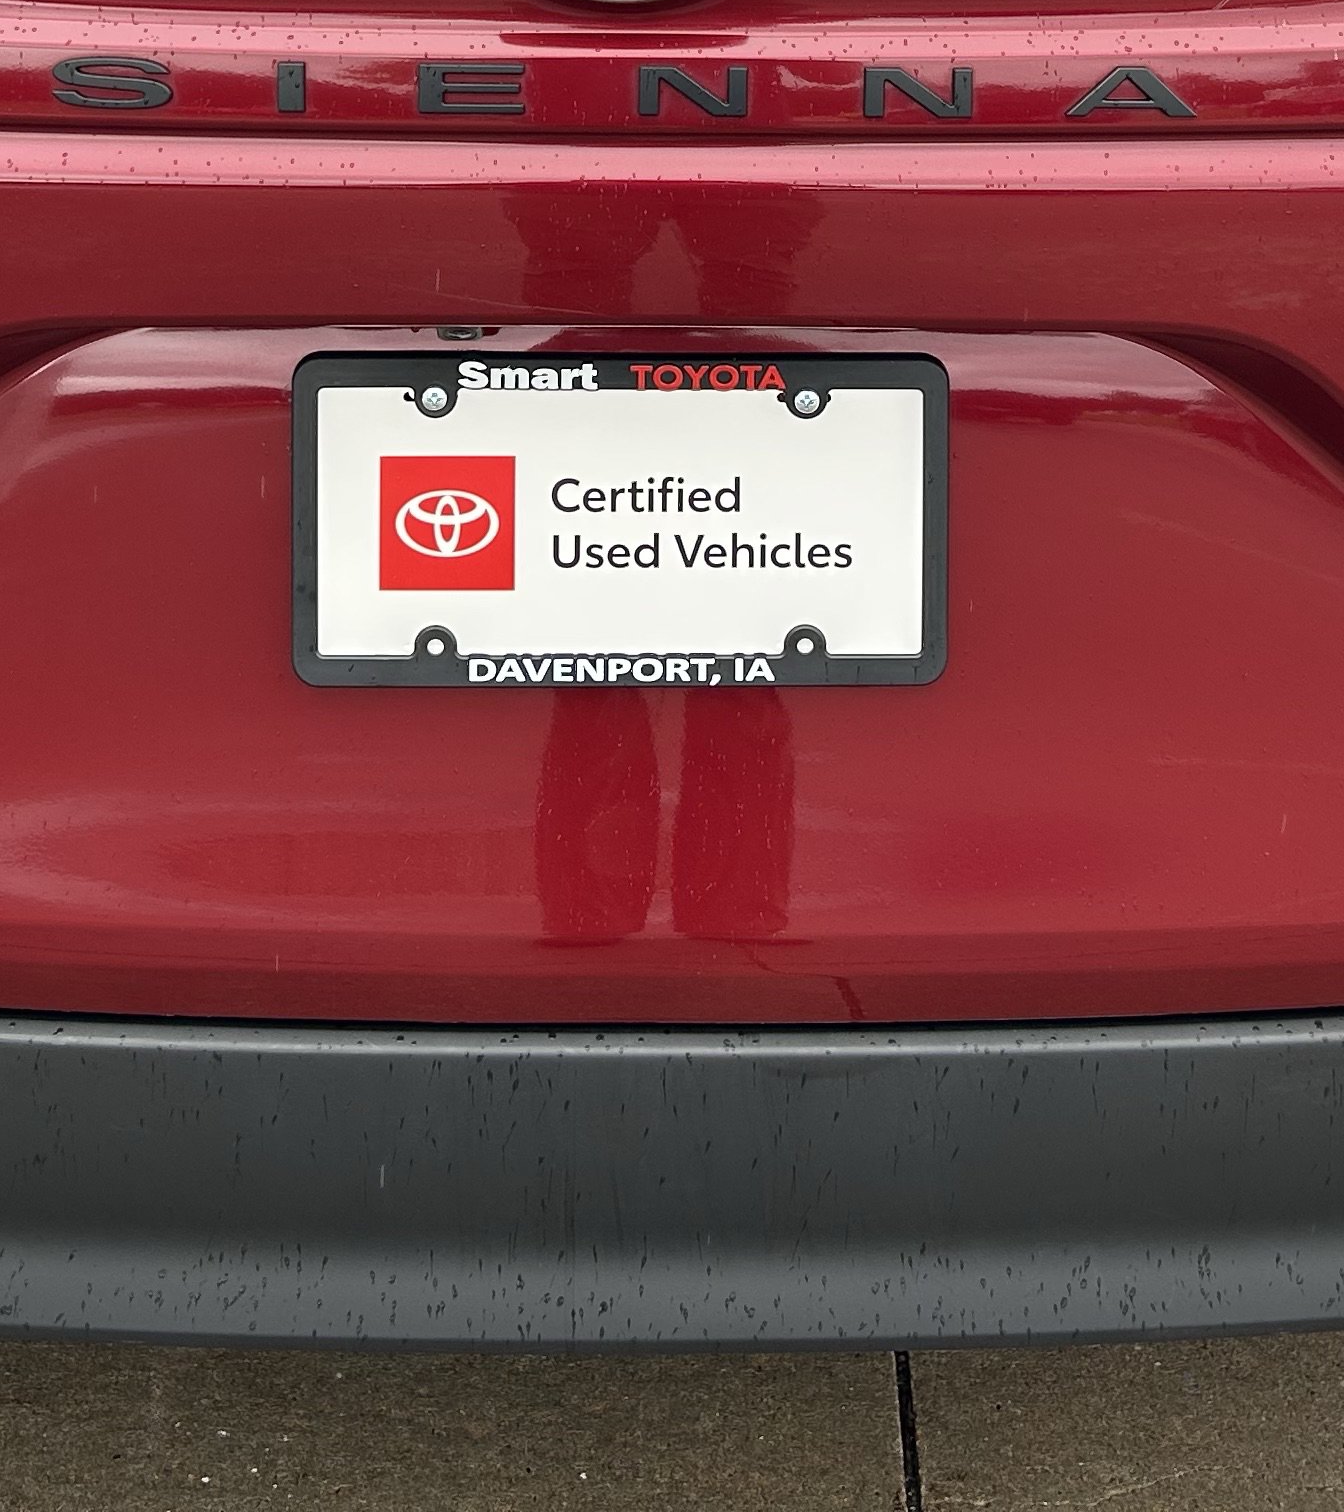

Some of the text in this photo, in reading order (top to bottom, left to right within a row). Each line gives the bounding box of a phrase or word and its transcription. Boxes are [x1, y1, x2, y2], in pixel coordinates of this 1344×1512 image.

[52, 57, 1197, 119] SIENNA
[458, 361, 786, 391] Smart TOYOTA
[551, 476, 741, 513] Certified
[552, 533, 853, 569] Used Vehicles
[468, 658, 775, 686] DAVENPORT, IA
